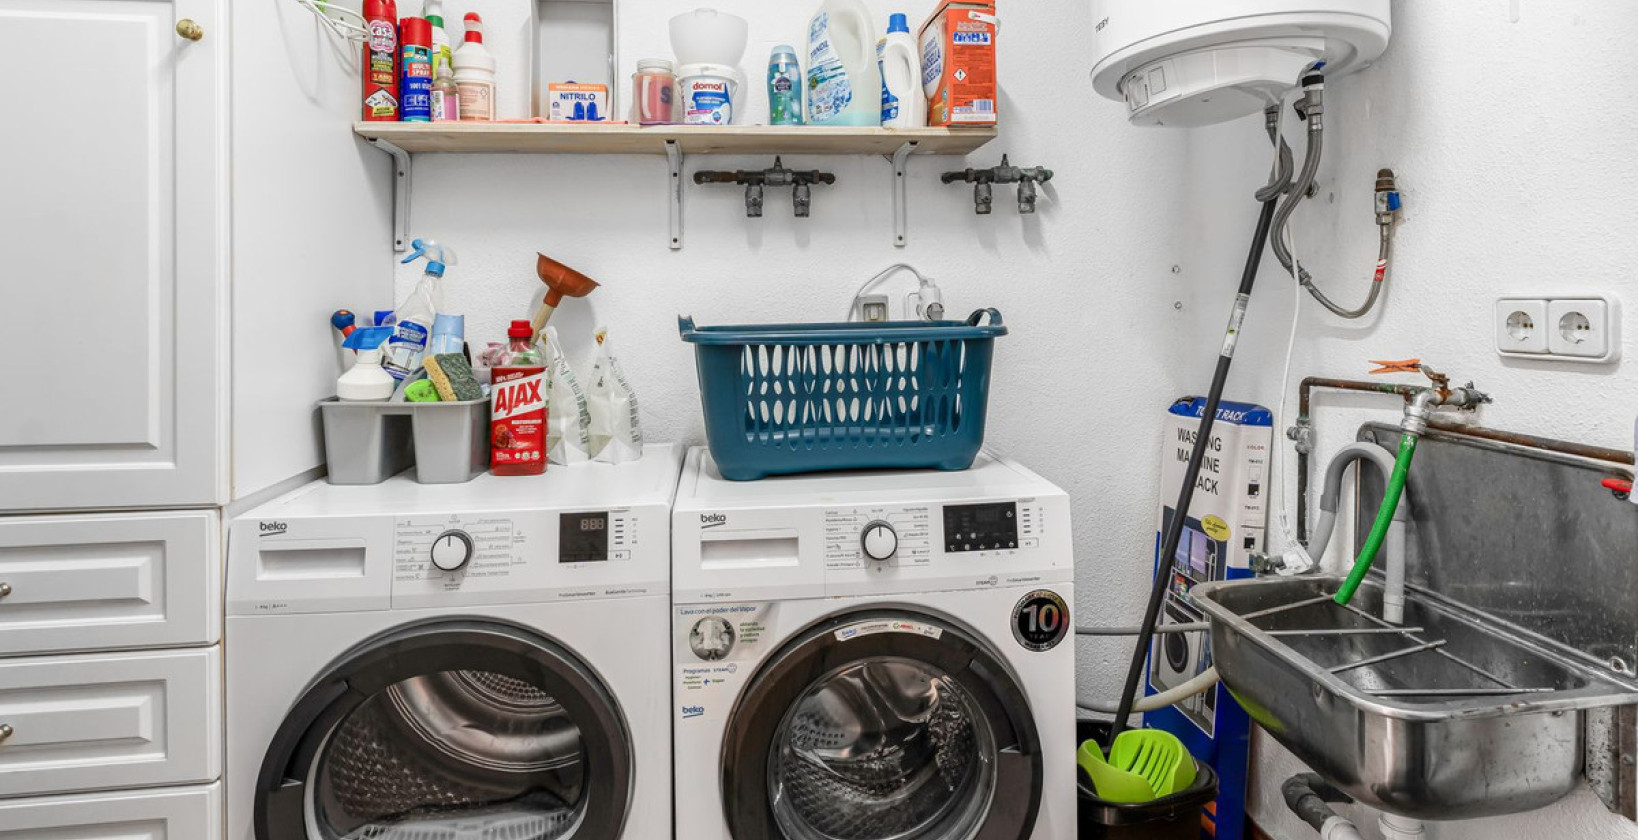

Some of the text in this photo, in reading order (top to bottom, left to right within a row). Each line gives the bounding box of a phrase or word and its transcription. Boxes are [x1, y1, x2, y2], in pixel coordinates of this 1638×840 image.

[693, 82, 723, 91] domol
[560, 93, 596, 101] NITRILO
[494, 379, 542, 416] AJAX
[1177, 427, 1222, 452] WASNG
[1177, 448, 1220, 473] MAINE
[1194, 475, 1219, 495] ACK
[259, 521, 288, 532] beko
[700, 513, 726, 523] beko
[1022, 603, 1060, 633] 10
